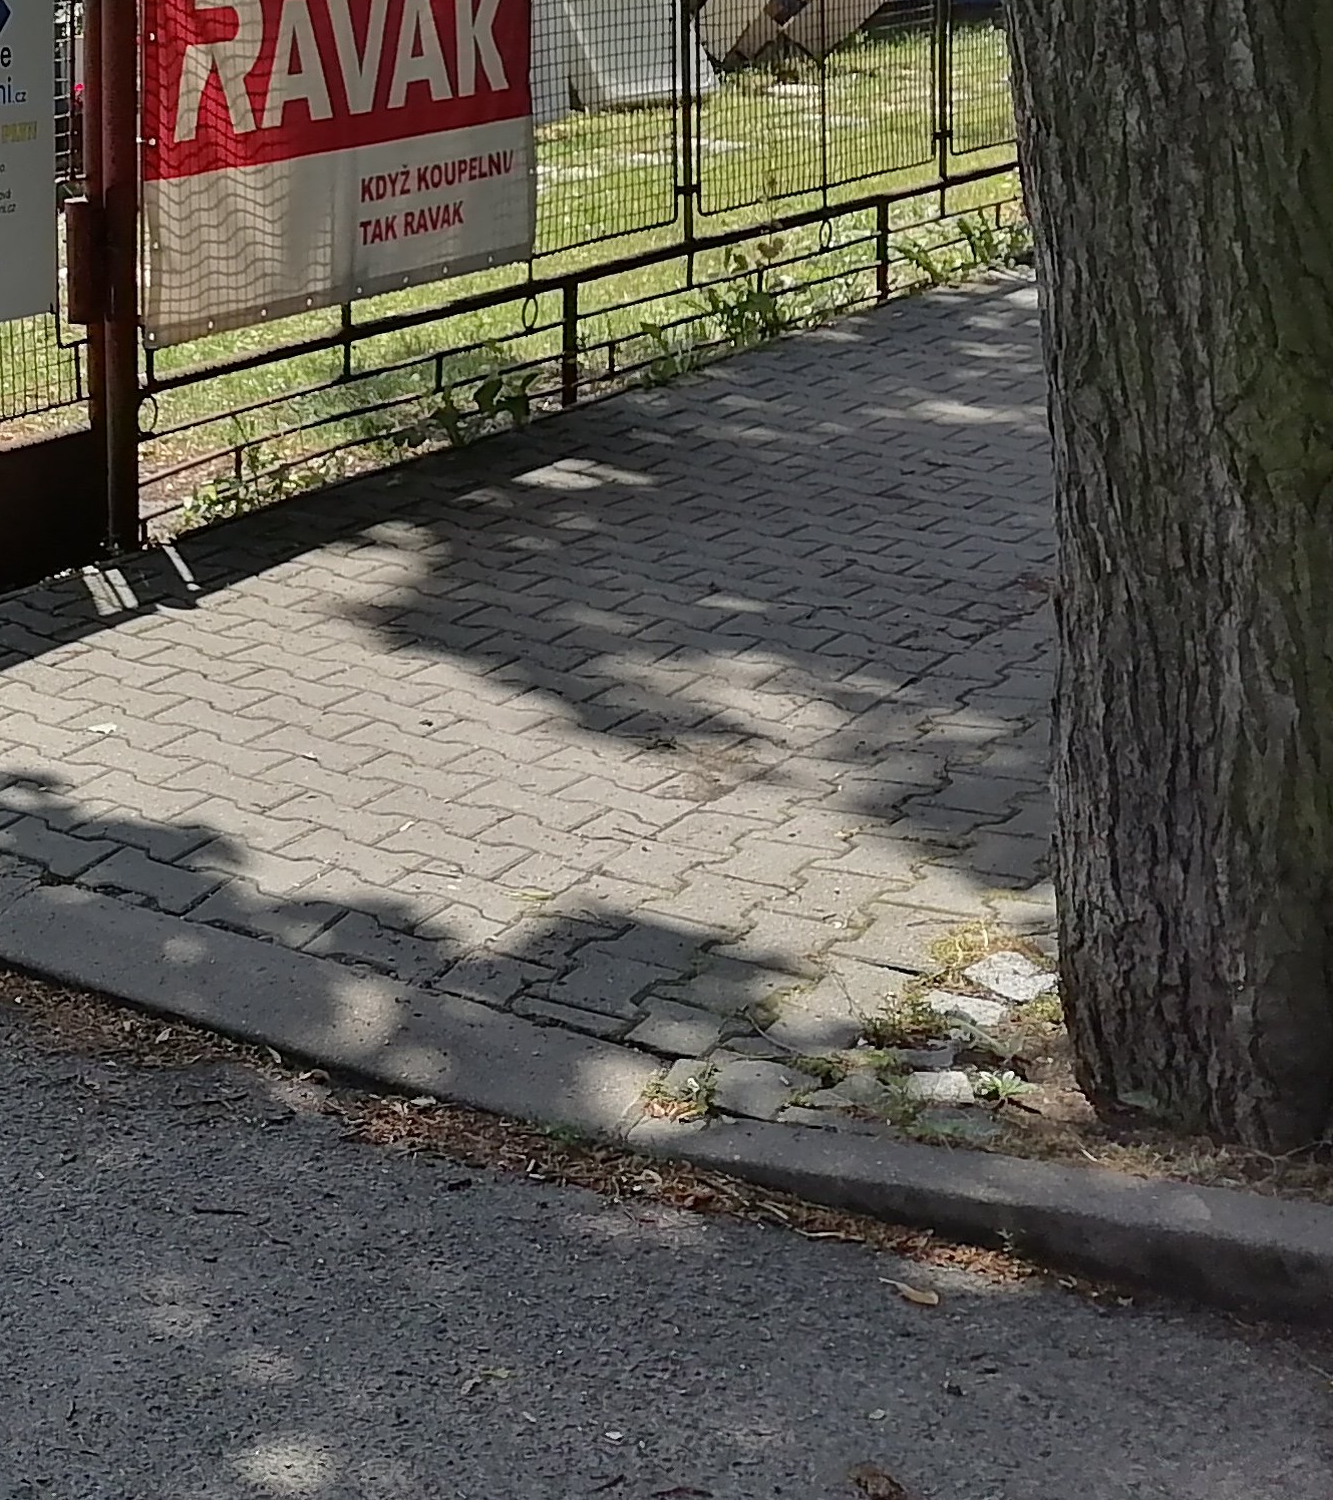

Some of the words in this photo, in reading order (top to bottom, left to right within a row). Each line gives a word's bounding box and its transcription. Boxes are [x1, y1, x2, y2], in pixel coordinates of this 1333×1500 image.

[360, 163, 412, 203] KDYŽ
[416, 150, 515, 192] KOUPELNU
[360, 213, 398, 246] TAK
[403, 200, 465, 237] RAVAK
